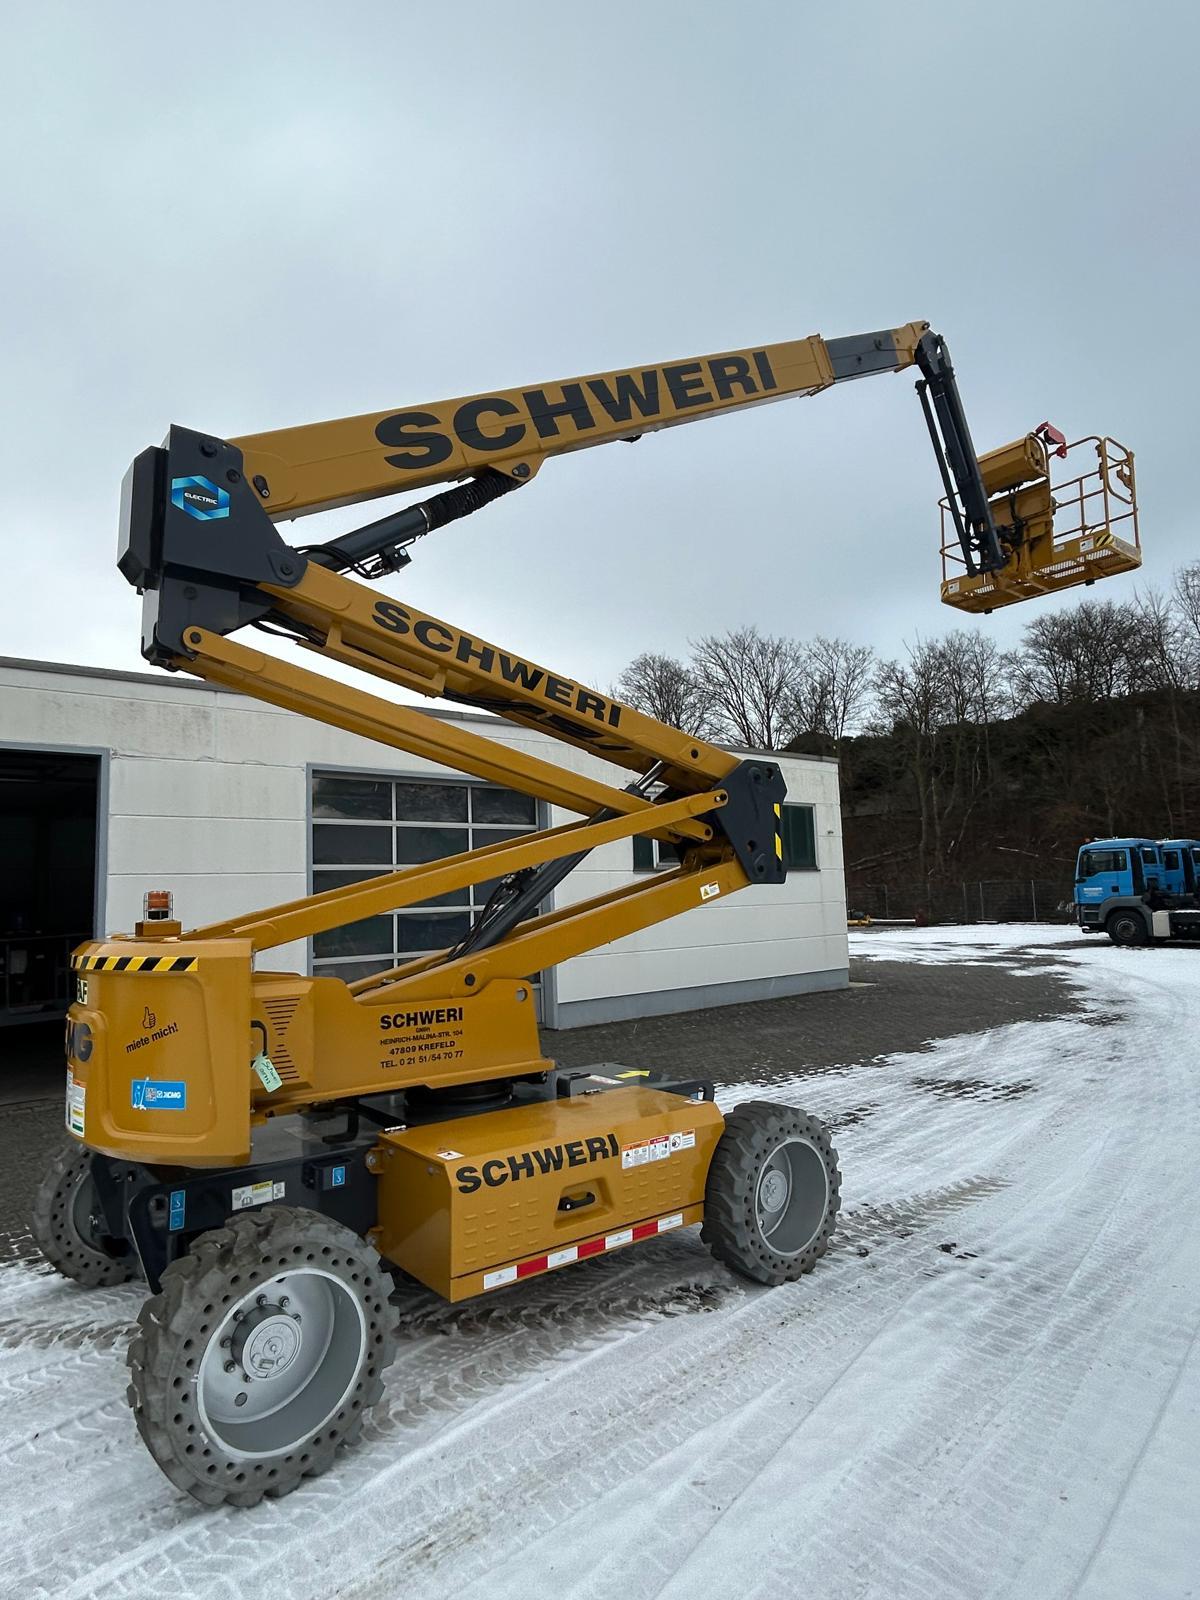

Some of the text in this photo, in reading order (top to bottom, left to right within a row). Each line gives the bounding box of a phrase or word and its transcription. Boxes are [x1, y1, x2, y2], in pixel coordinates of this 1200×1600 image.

[374, 351, 777, 469] SCHWERI
[184, 492, 218, 504] ELECTRIC
[372, 601, 622, 727] SCHWERI
[380, 1007, 463, 1030] SCHWERI
[126, 1022, 178, 1053] miete mich!
[389, 1041, 456, 1056] 47809 KREFELD
[380, 1060, 398, 1069] TEL.
[399, 1058, 405, 1066] 0
[455, 1050, 464, 1058] 77
[456, 1133, 619, 1194] SCHWERI
